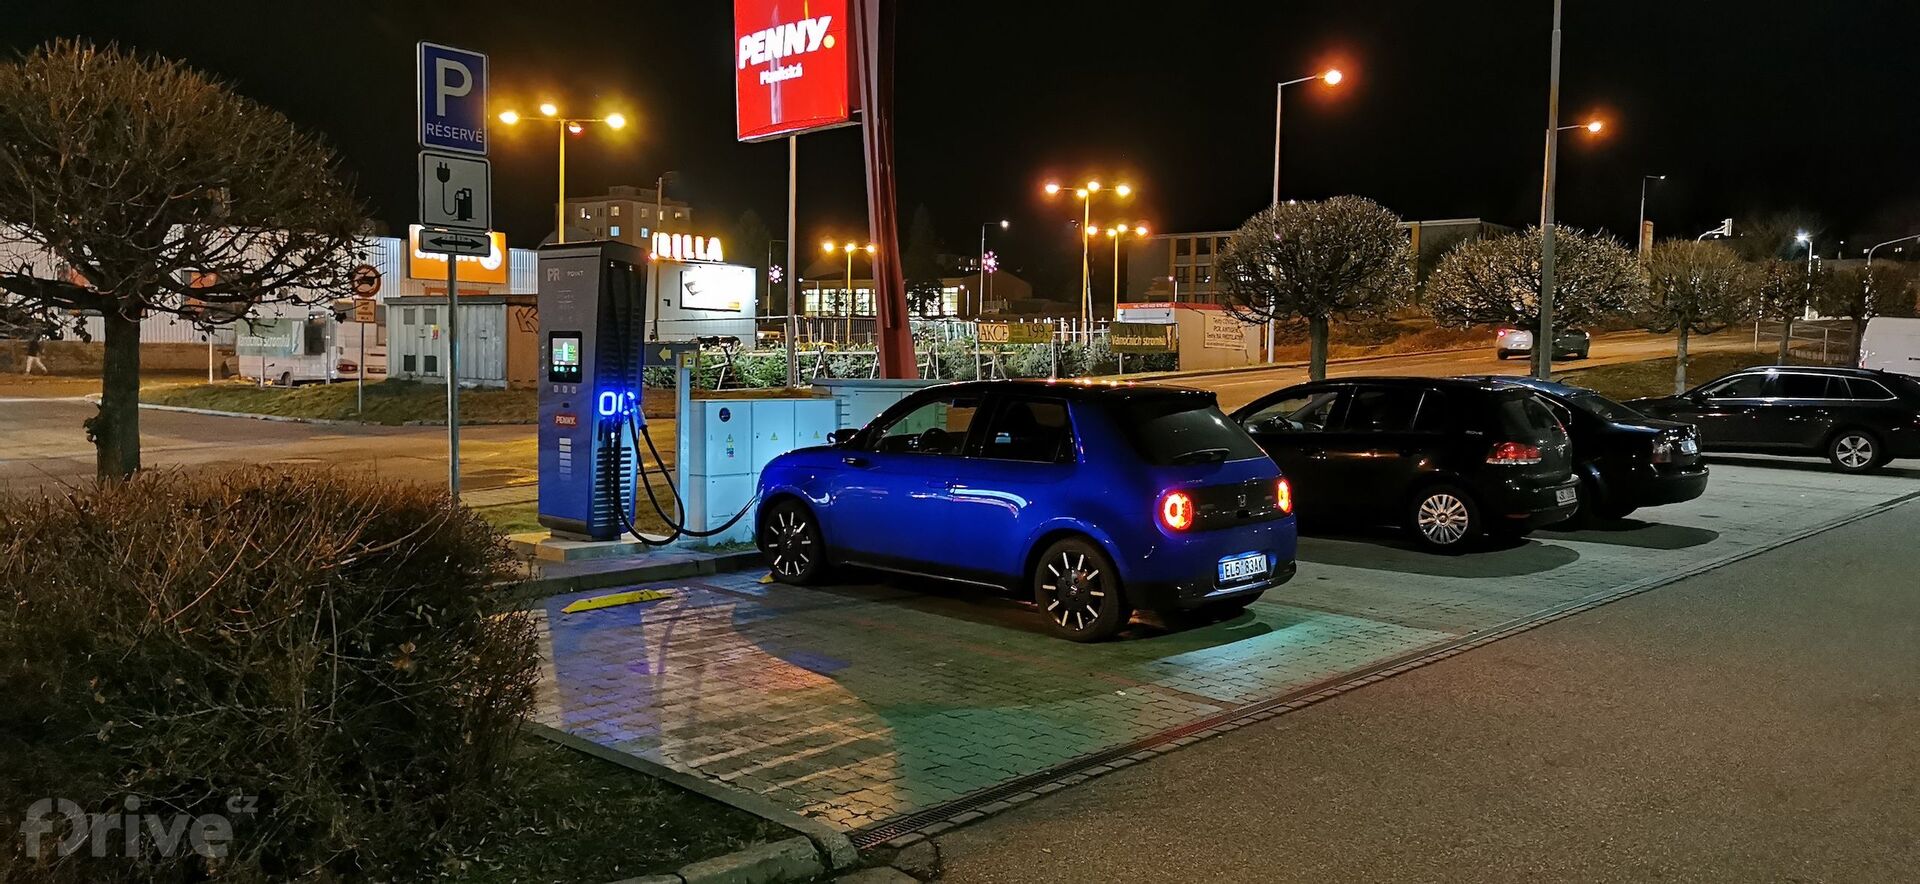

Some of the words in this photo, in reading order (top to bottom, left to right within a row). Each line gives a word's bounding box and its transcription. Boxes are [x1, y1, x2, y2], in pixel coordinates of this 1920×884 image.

[436, 57, 473, 117] P
[426, 121, 484, 143] RÉSERVÉ
[979, 324, 1008, 341] AKCE
